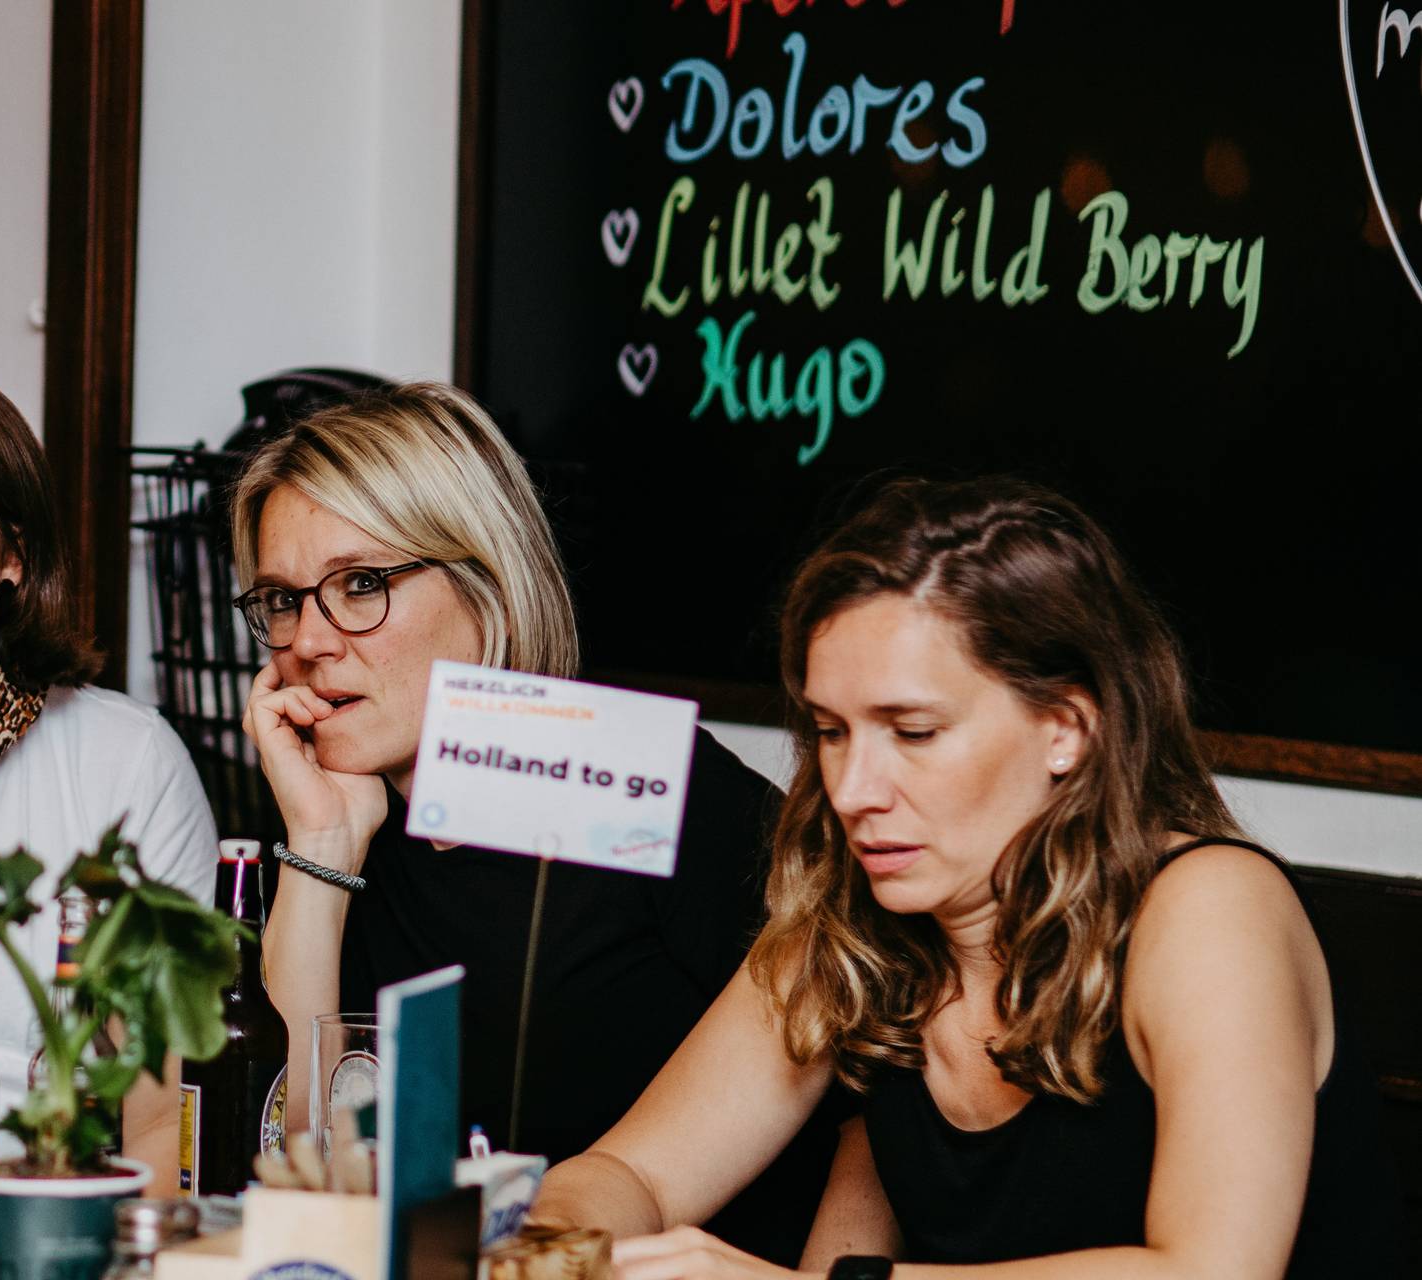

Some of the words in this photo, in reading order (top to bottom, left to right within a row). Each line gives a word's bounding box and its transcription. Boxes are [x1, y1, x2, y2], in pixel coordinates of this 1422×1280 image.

[661, 31, 987, 168] Dolores
[640, 176, 842, 317] Lillet
[882, 184, 1052, 308] Wild
[1075, 190, 1265, 360] Berry
[690, 311, 885, 466] Hugo
[437, 738, 570, 782] Holland
[582, 763, 614, 788] to
[625, 774, 668, 799] go
